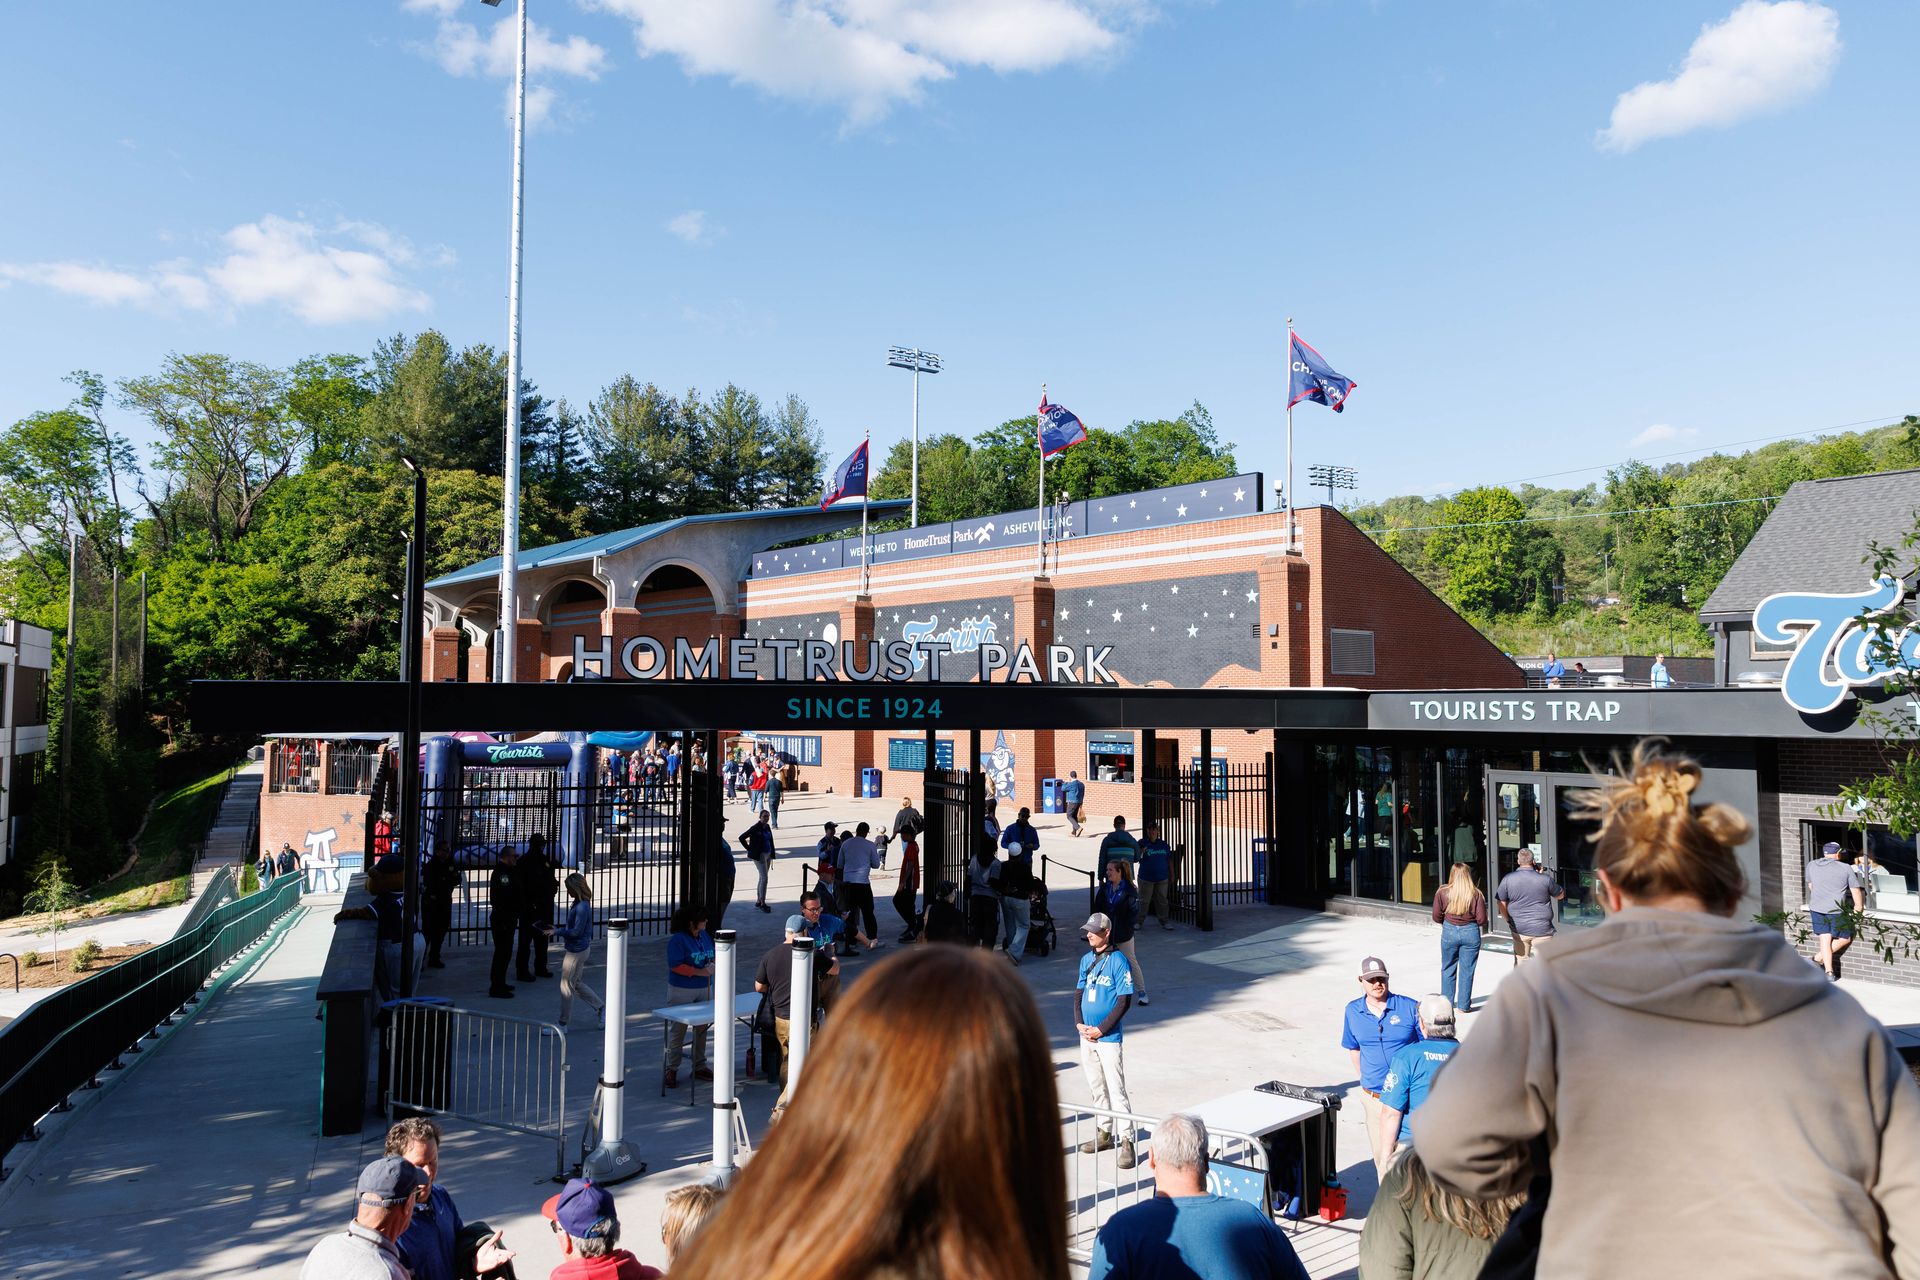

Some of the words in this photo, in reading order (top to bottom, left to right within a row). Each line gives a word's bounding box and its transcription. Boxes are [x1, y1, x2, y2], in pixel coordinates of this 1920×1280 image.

[849, 543, 885, 557] WELCOME
[886, 541, 898, 552] TO
[903, 533, 951, 549] HomeTrust
[953, 528, 974, 543] Park
[1058, 516, 1073, 528] NC
[572, 634, 951, 684] HOMETRUST
[978, 642, 1119, 685] PARK
[787, 697, 871, 719] SINCE
[883, 698, 943, 719] 1924
[1410, 700, 1536, 721] TOURISTS
[1546, 701, 1621, 722] TRAP
[486, 744, 545, 763] Tourists
